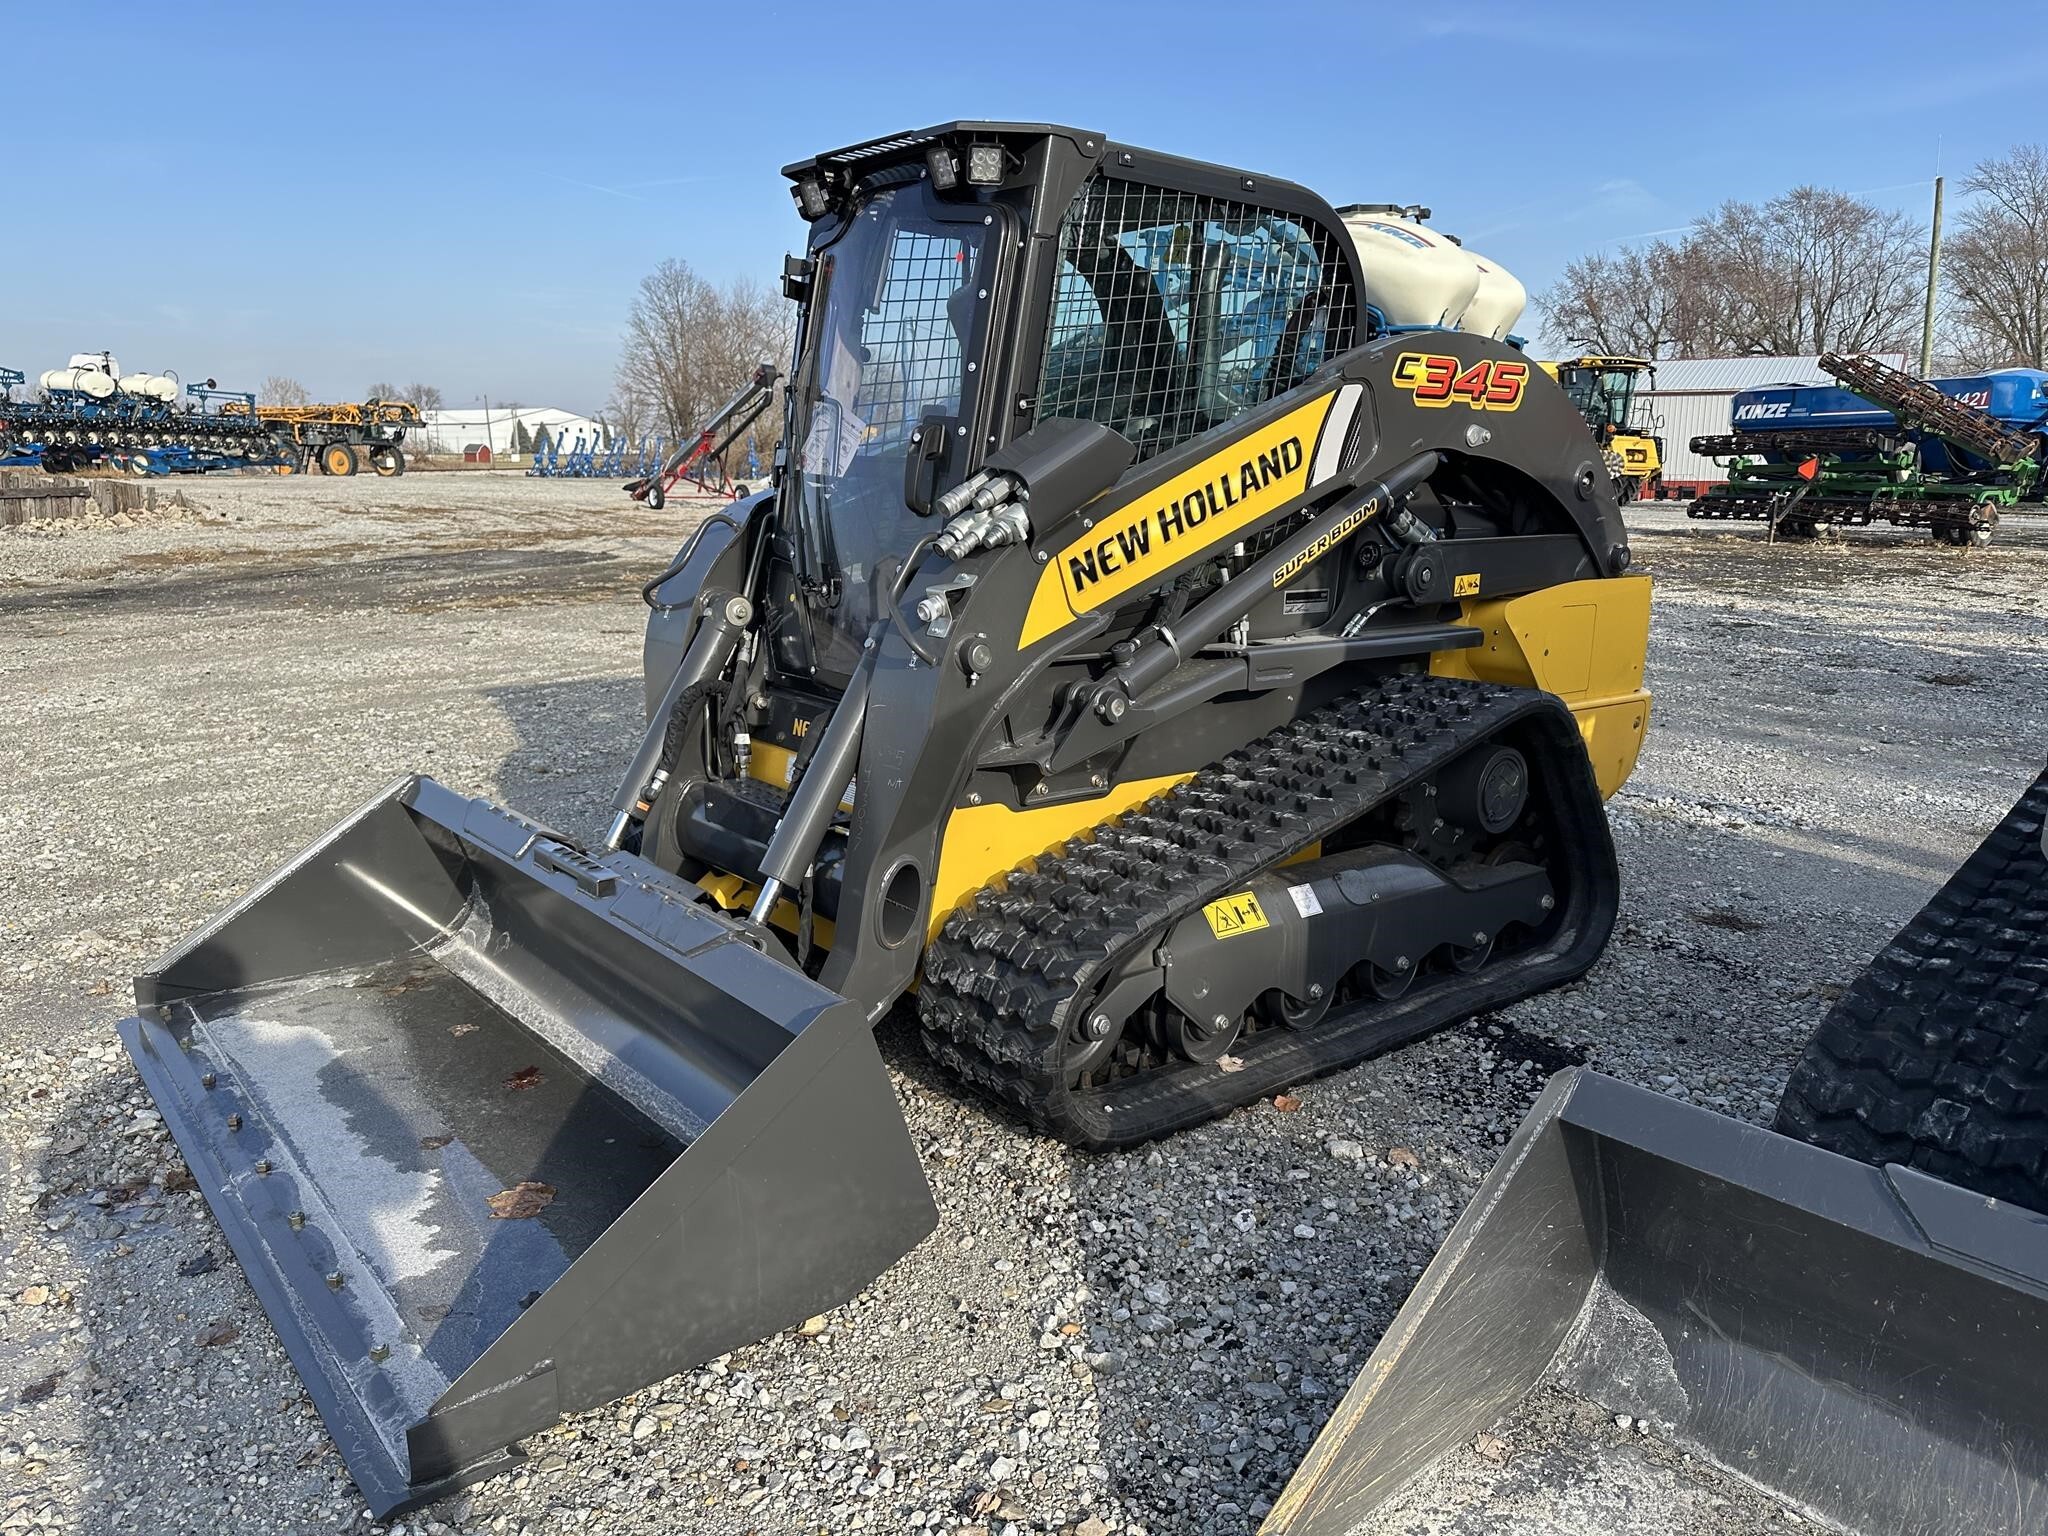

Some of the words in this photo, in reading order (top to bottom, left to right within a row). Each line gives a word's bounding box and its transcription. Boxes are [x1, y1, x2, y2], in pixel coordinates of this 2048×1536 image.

[1734, 402, 1791, 420] KINZE
[1069, 516, 1150, 593] NEW
[1157, 436, 1303, 544] HOLLAND
[1273, 534, 1329, 587] SUPER
[1330, 499, 1377, 544] BOOM
